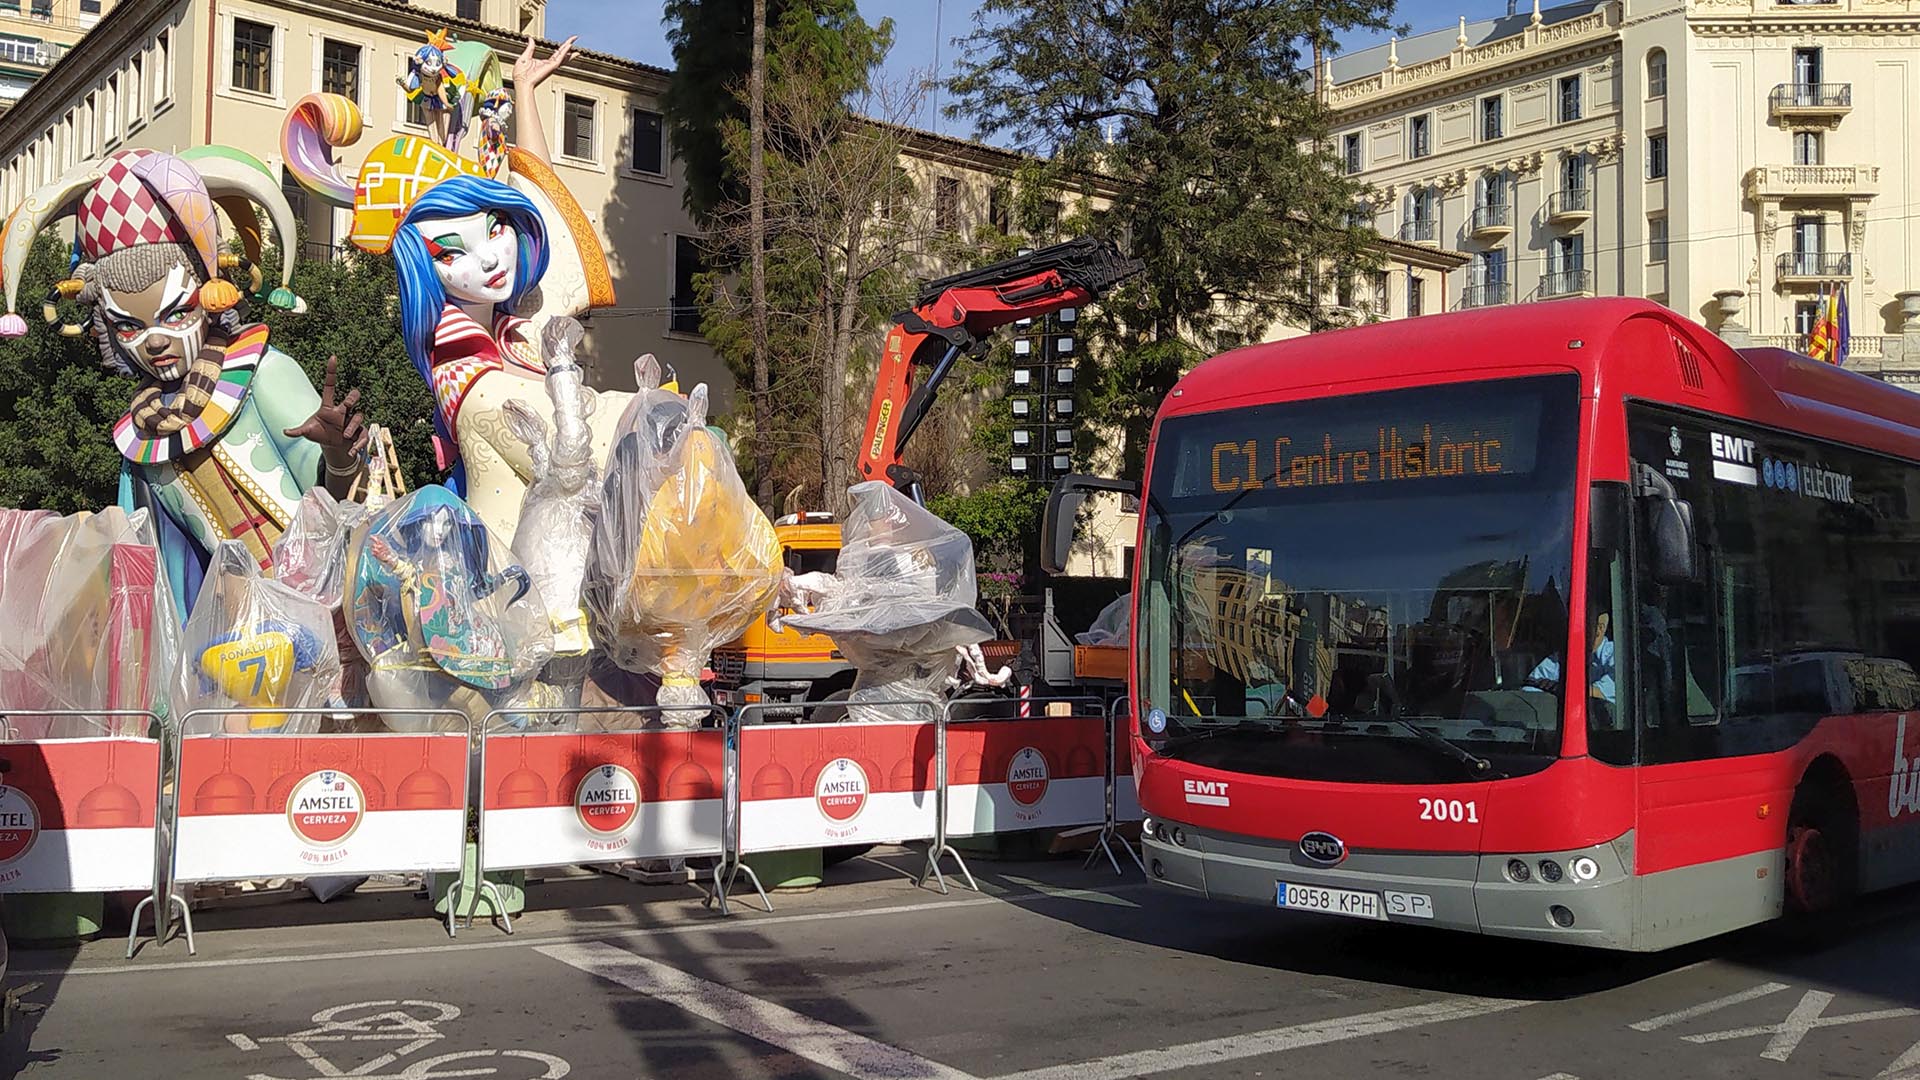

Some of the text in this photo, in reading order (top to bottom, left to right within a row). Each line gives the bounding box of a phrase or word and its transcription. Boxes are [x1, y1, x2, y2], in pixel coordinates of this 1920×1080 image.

[1711, 431, 1756, 464] EMT
[1211, 439, 1265, 492] C1
[1274, 431, 1371, 488] Centre
[238, 656, 266, 697] 7
[1013, 767, 1044, 780] AMSTEL
[823, 781, 861, 794] AMSTEL
[1183, 779, 1230, 796] EMT
[298, 796, 354, 810] AMSTEL
[585, 788, 631, 803] AMSTEL
[826, 796, 857, 806] CERVEZA
[588, 806, 626, 816] CERVEZA
[1418, 797, 1479, 824] 2001
[302, 814, 347, 825] CERVEZA
[606, 837, 629, 851] MALTA
[1303, 839, 1340, 857] BYD
[322, 848, 348, 863] MALTA
[1288, 886, 1373, 915] 0958 KPH
[1391, 894, 1426, 914] SP
